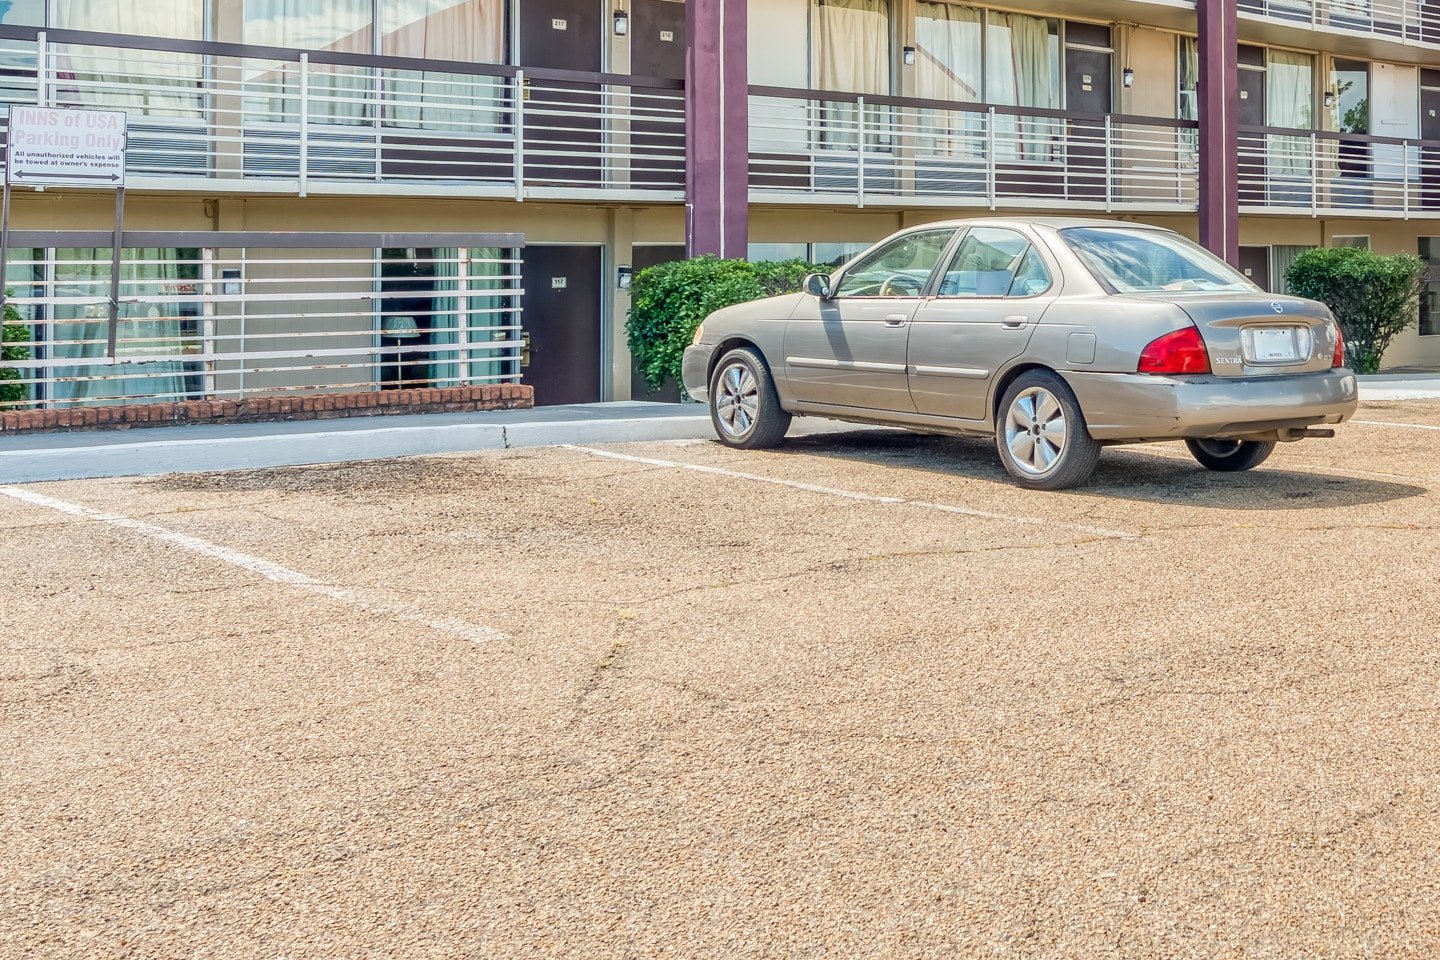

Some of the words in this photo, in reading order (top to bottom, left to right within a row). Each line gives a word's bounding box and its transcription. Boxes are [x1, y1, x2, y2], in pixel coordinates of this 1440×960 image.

[19, 110, 58, 126] INNS
[64, 114, 80, 127] of
[86, 114, 118, 129] USA
[15, 130, 79, 149] Parking
[85, 133, 120, 151] Only
